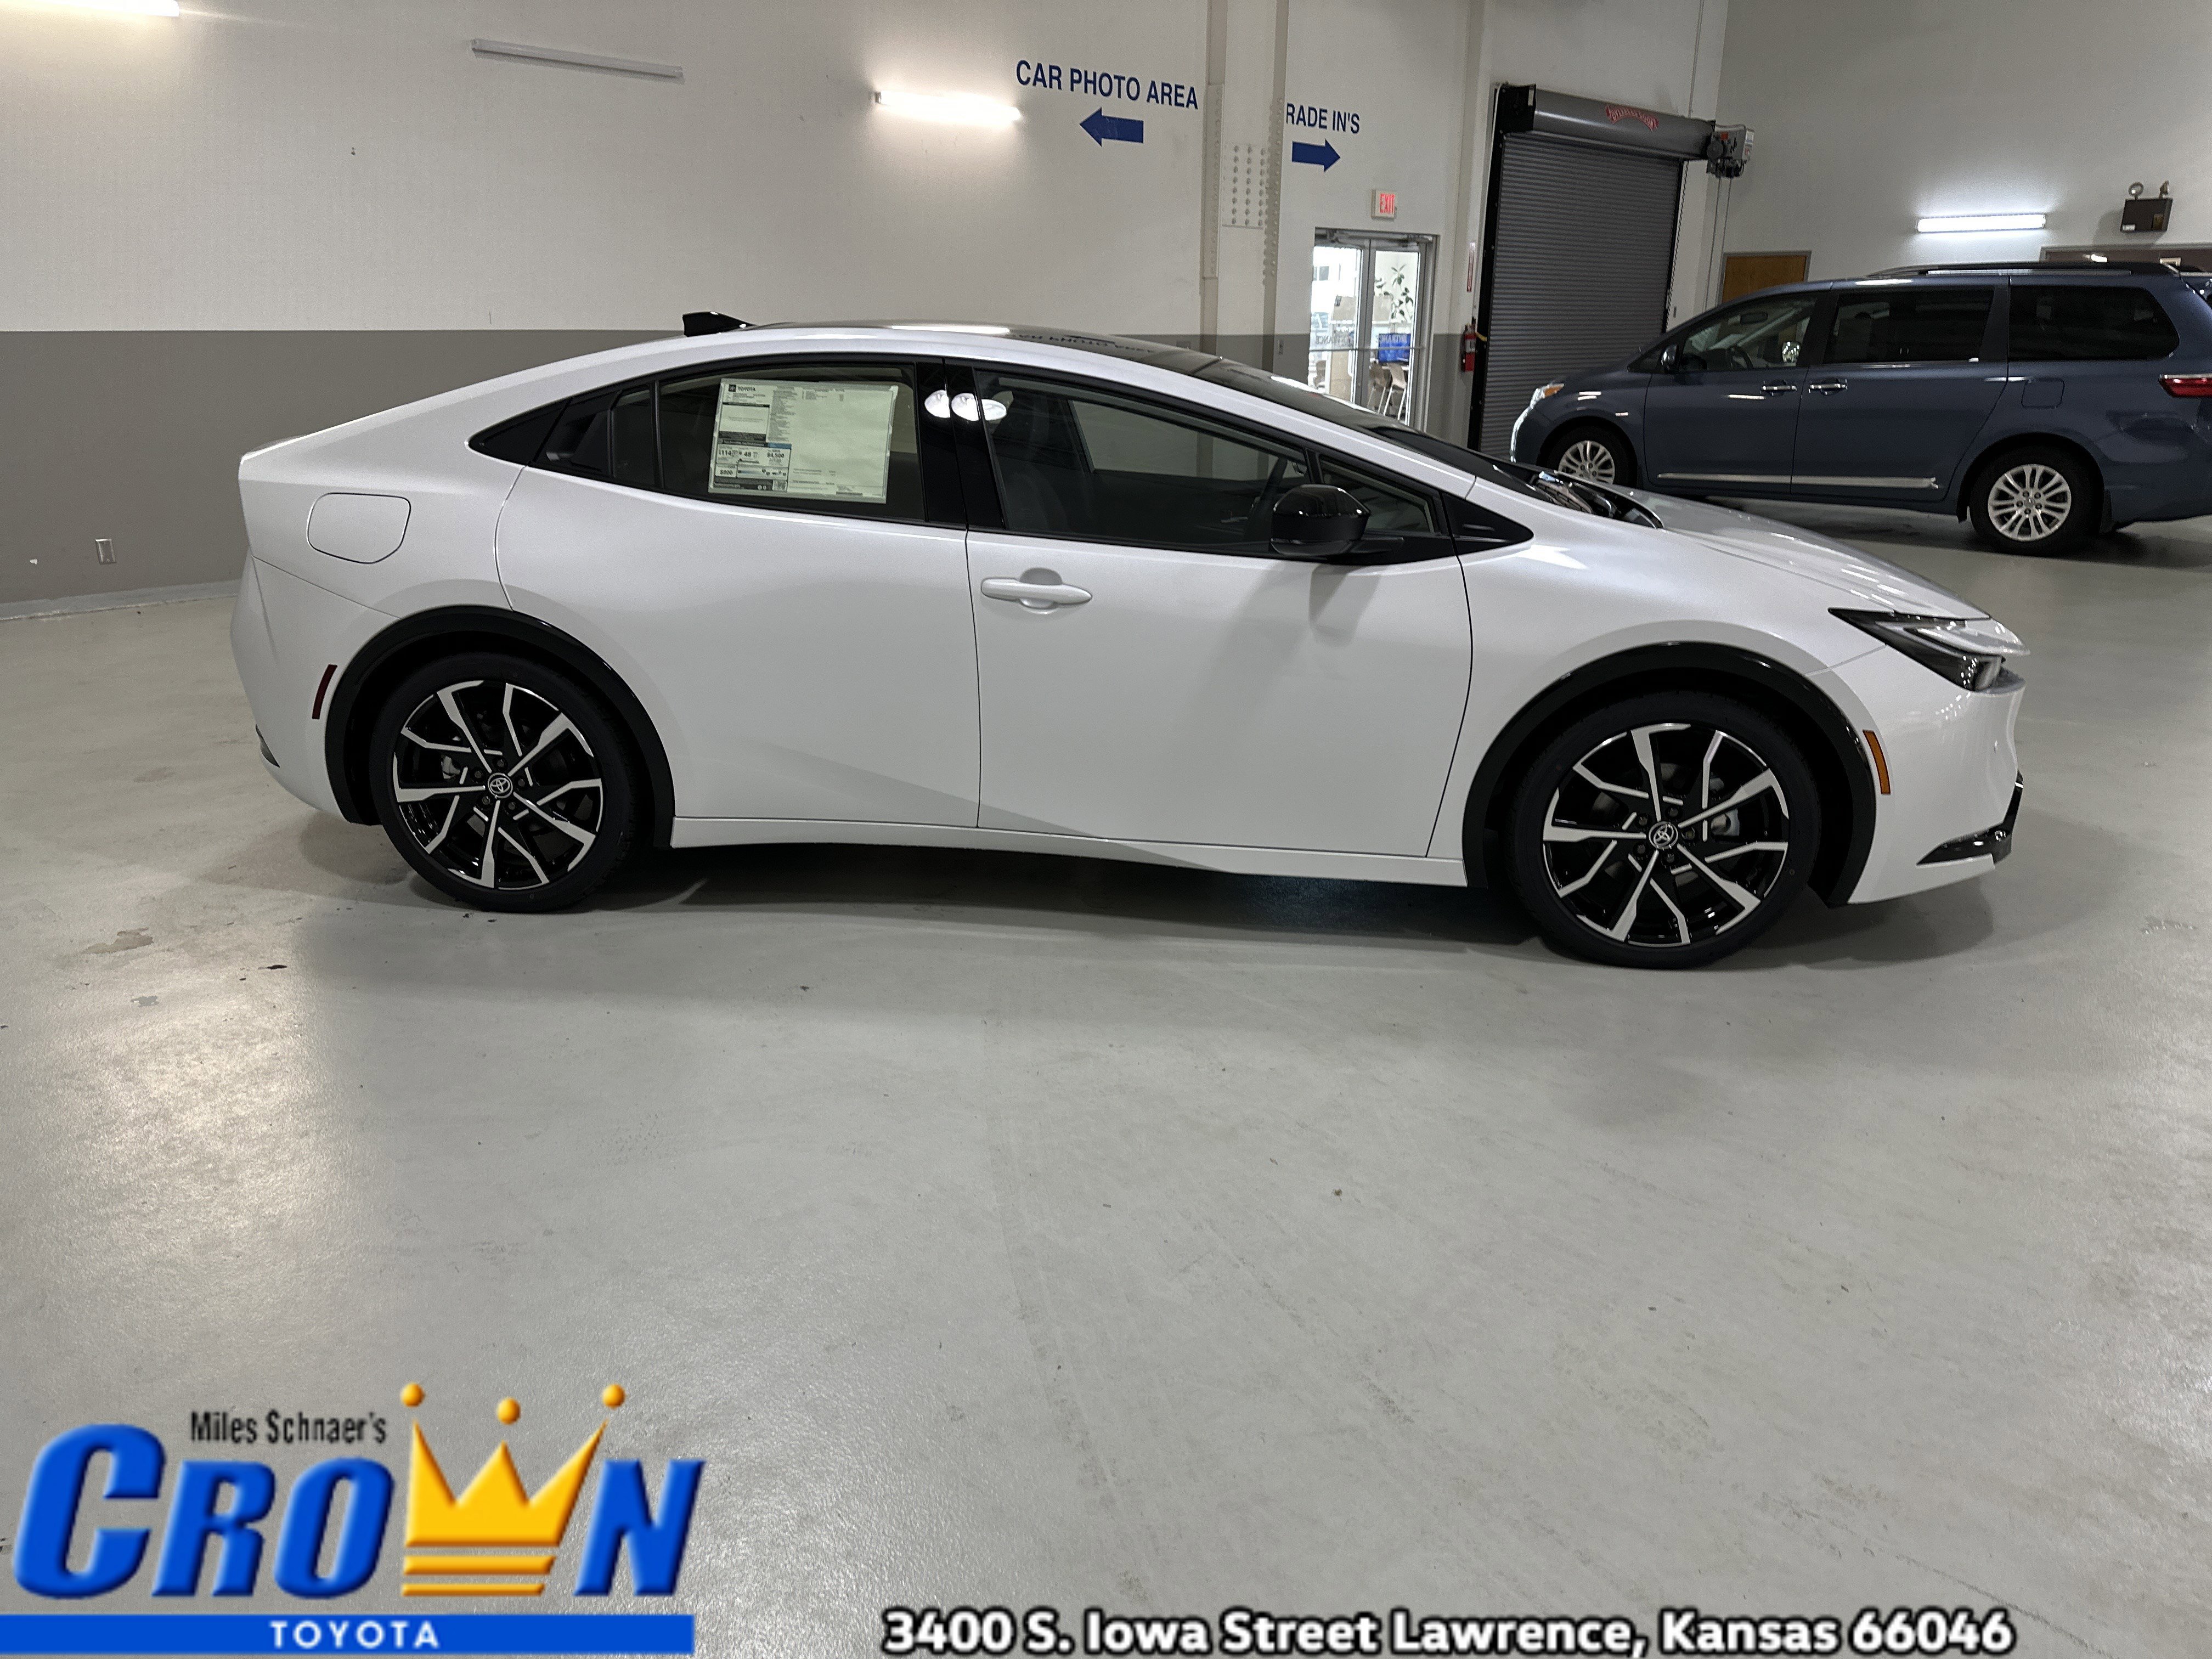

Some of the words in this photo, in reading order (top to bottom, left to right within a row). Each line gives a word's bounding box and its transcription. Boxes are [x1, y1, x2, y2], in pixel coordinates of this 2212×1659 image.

[1016, 60, 1062, 91] CAR
[1070, 67, 1141, 101] PHOTO
[1146, 80, 1198, 110] AREA
[1286, 103, 1328, 130] RADE
[1333, 110, 1360, 134] IN'S
[1379, 193, 1396, 213] EXIT
